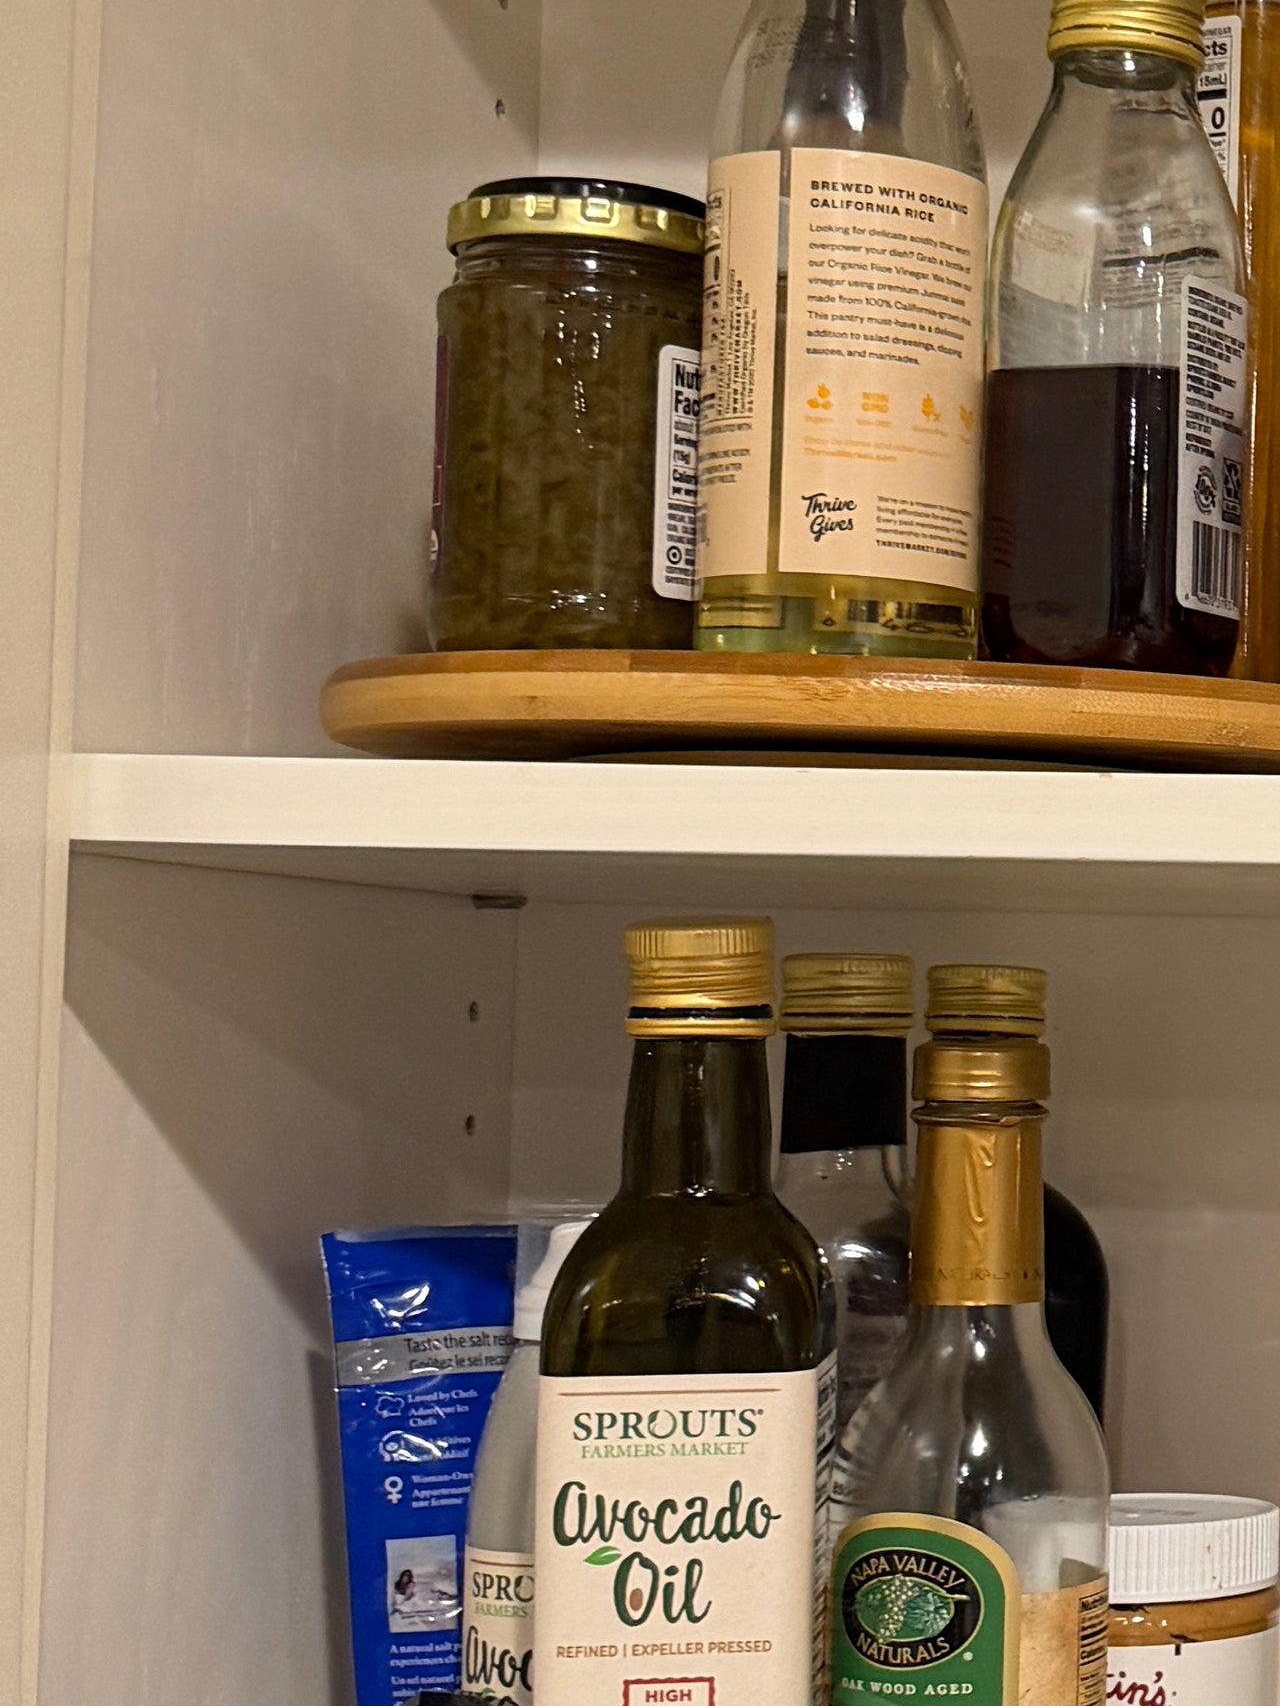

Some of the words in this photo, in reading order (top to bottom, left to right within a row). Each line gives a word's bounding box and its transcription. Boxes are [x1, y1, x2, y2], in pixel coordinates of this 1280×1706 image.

[810, 198, 900, 216] CALIFORNIA
[905, 208, 935, 222] RICE
[811, 180, 874, 194] BREWED
[879, 186, 915, 200] WITH
[919, 193, 968, 214] ORGANIC
[802, 493, 857, 517] Thrive
[810, 515, 854, 542] Gives
[404, 1338, 441, 1352] Taste
[444, 1335, 465, 1348] the
[470, 1332, 489, 1342] salt
[573, 1408, 758, 1441] SPROUTS
[581, 1444, 665, 1459] FARMERS
[670, 1442, 749, 1456] MARKET
[553, 1480, 782, 1546] Avocado
[850, 1556, 889, 1586] NAPA
[893, 1554, 965, 1588] VALLEY
[472, 1572, 534, 1602] SPRO
[614, 1551, 712, 1627] Oil
[556, 1646, 619, 1658] REFINED
[632, 1643, 703, 1657] EXPELLER
[708, 1640, 772, 1653] PRESSED
[857, 1632, 950, 1664] NATURALS
[645, 1689, 692, 1702] HIGH
[842, 1677, 865, 1691] OAK
[870, 1682, 916, 1695] WOOD
[924, 1683, 973, 1695] AGED
